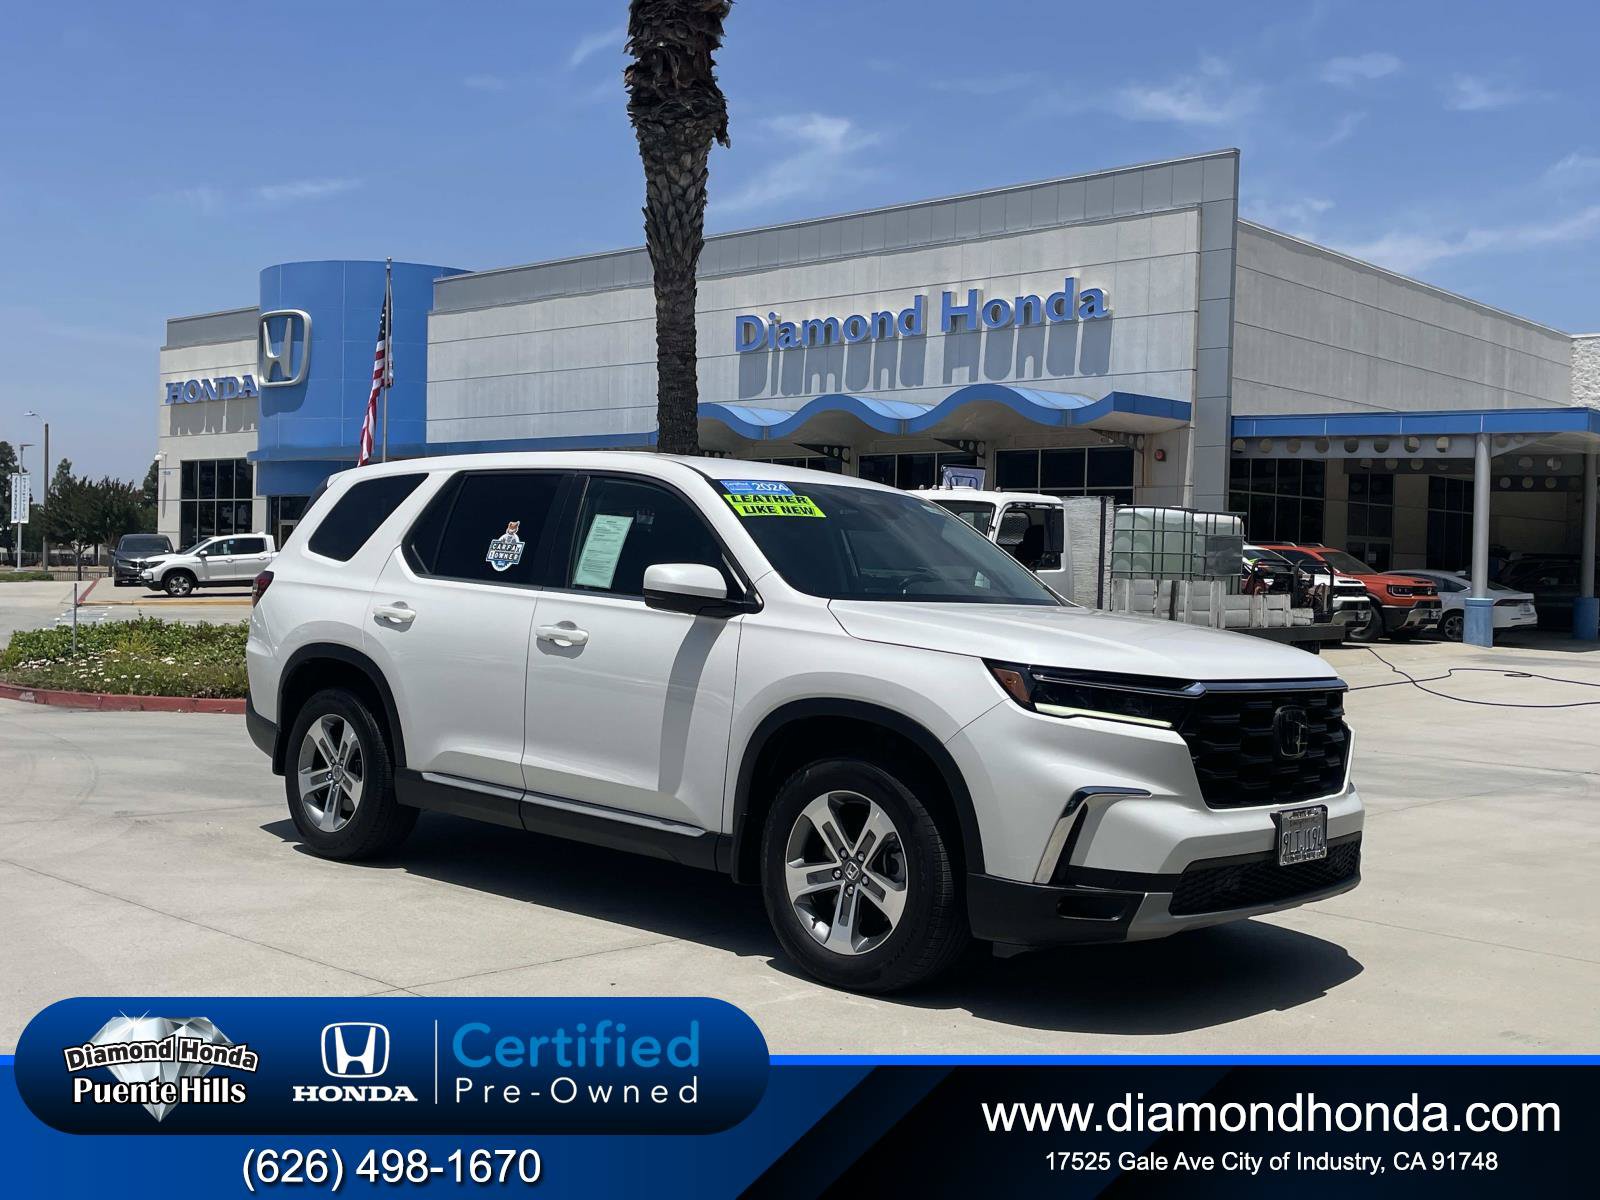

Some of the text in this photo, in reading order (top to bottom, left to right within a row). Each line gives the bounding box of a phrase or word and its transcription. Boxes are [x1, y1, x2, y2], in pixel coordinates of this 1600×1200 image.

[735, 276, 1111, 354] Diamond Honda
[165, 374, 258, 404] HONDA
[751, 482, 788, 491] 2024
[731, 495, 807, 504] LEATHER
[742, 504, 815, 515] LIKE NEW
[492, 543, 521, 553] CARFAX
